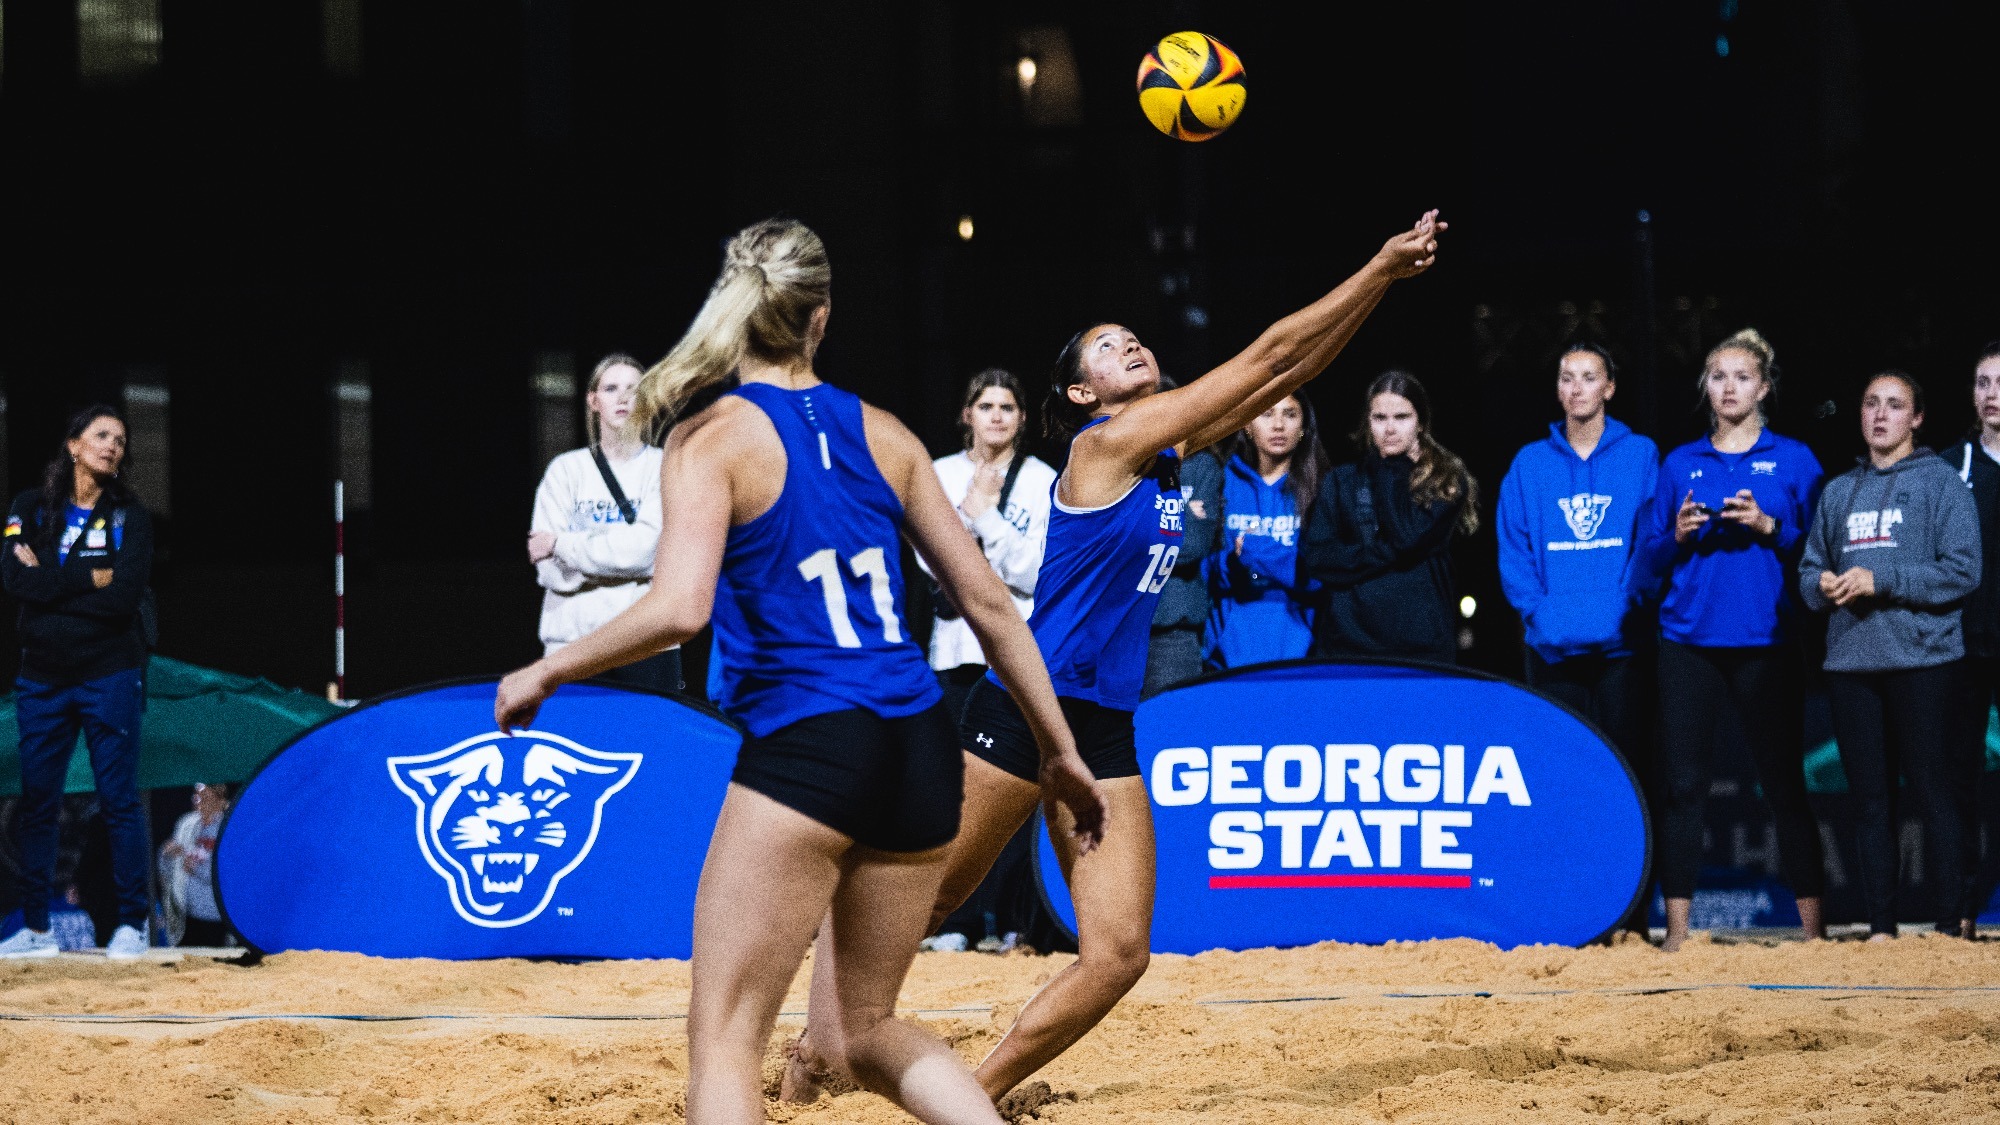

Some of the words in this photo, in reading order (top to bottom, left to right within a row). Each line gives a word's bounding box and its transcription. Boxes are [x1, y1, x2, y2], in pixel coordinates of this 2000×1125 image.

[1849, 525, 1892, 541] STAE
[1136, 543, 1180, 594] 19
[797, 547, 903, 648] 11
[1151, 744, 1532, 807] GEORGIA
[1208, 809, 1473, 869] STATE
[557, 907, 574, 917] TM
